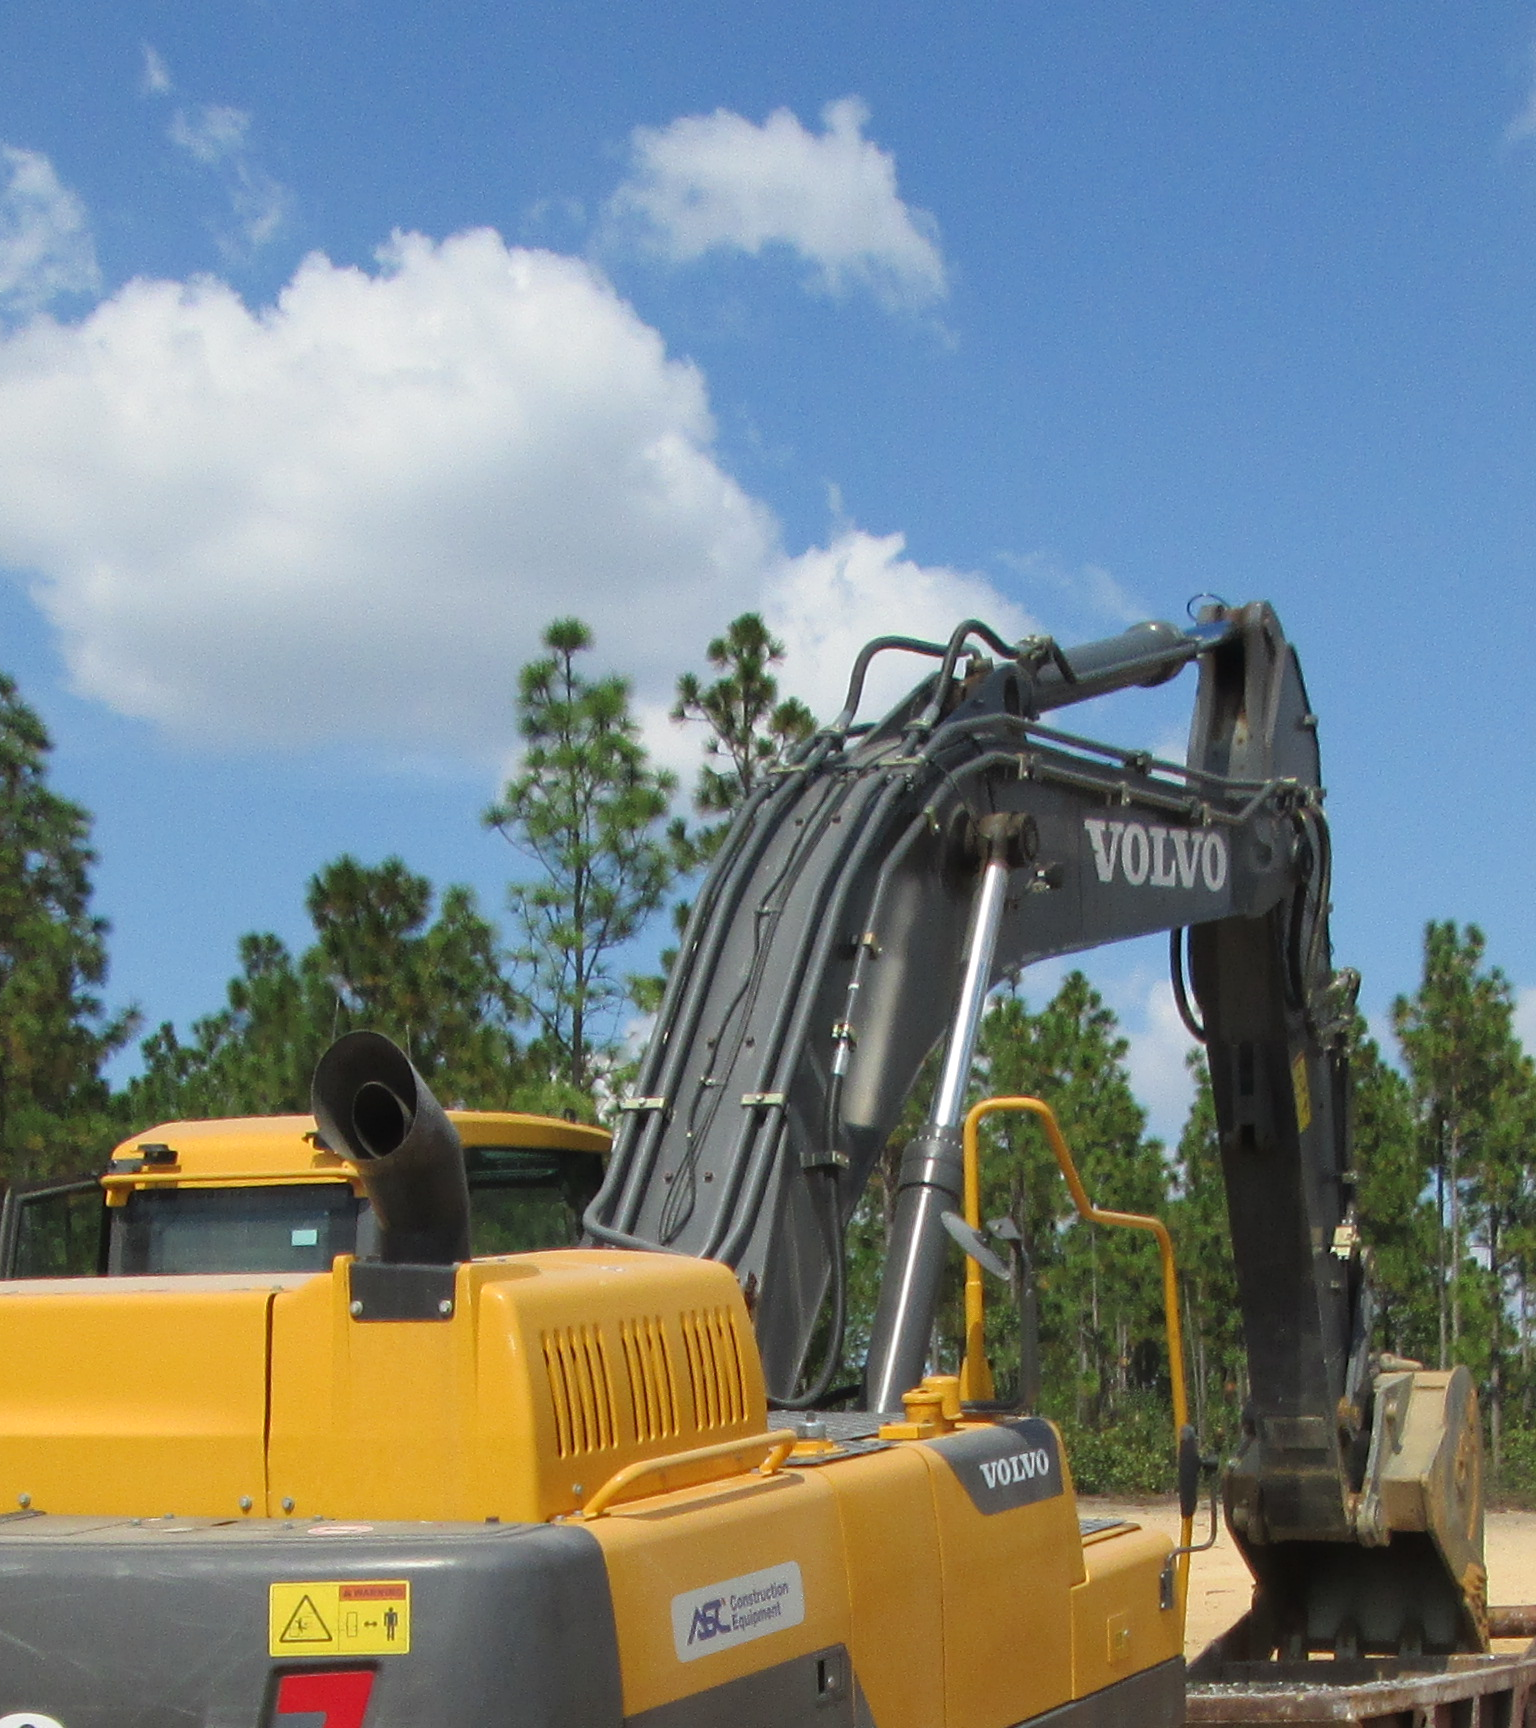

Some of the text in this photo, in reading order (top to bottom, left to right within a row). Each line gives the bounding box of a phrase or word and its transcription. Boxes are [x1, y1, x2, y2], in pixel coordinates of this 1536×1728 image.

[1084, 819, 1227, 892] VOLVO
[979, 1449, 1049, 1489] VOLVO
[730, 1582, 789, 1611] Construction
[731, 1601, 782, 1631] Equipment
